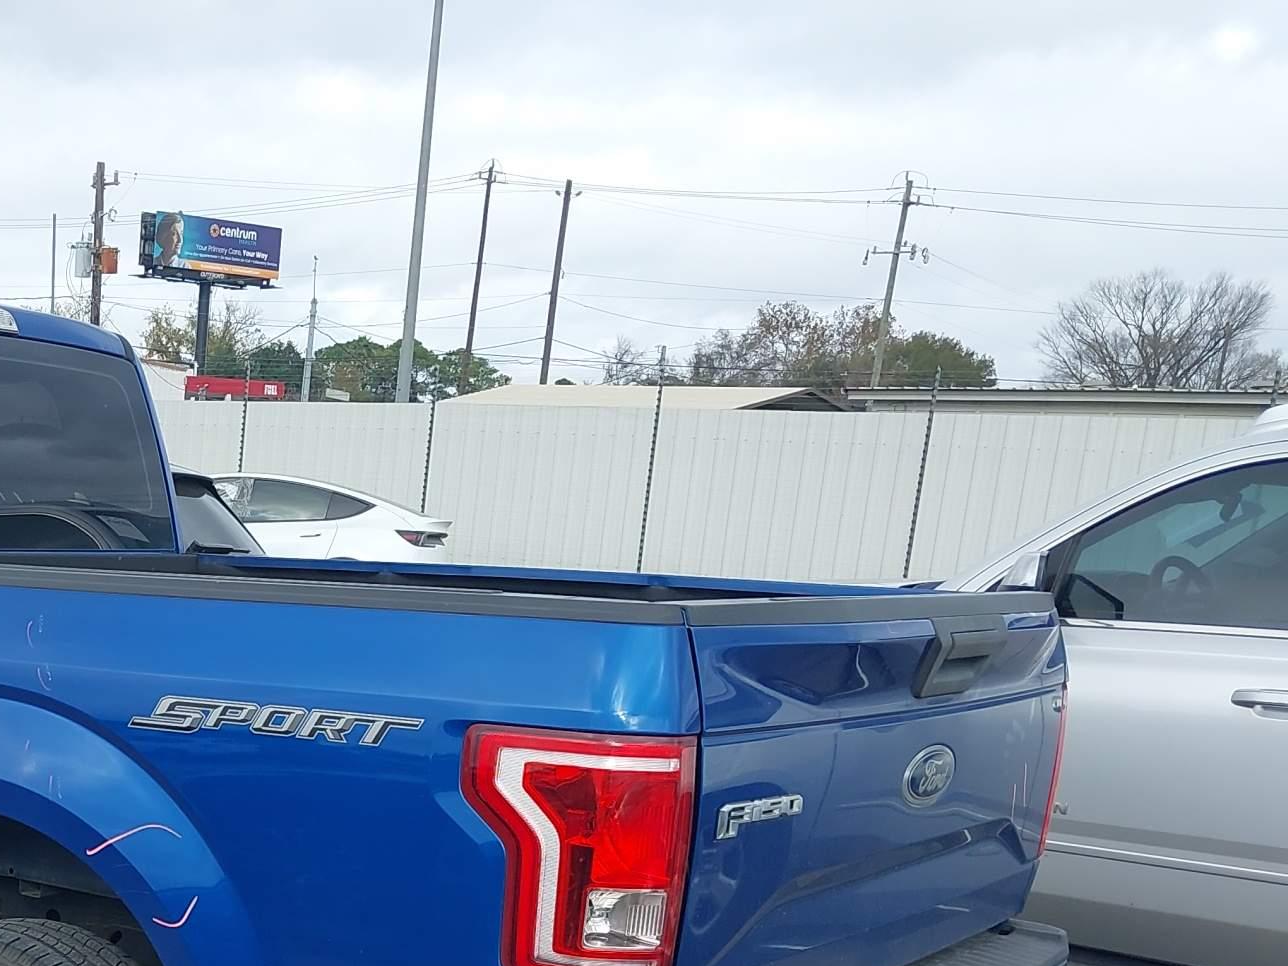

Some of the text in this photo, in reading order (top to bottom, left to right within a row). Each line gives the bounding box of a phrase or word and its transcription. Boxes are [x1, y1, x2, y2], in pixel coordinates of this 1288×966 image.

[220, 227, 257, 241] centrum
[196, 243, 208, 251] Your
[207, 245, 228, 256] Primary
[243, 249, 255, 257] Your
[256, 251, 269, 261] Way
[127, 694, 425, 748] SPORT
[920, 759, 949, 793] Ford
[716, 793, 804, 840] F150
